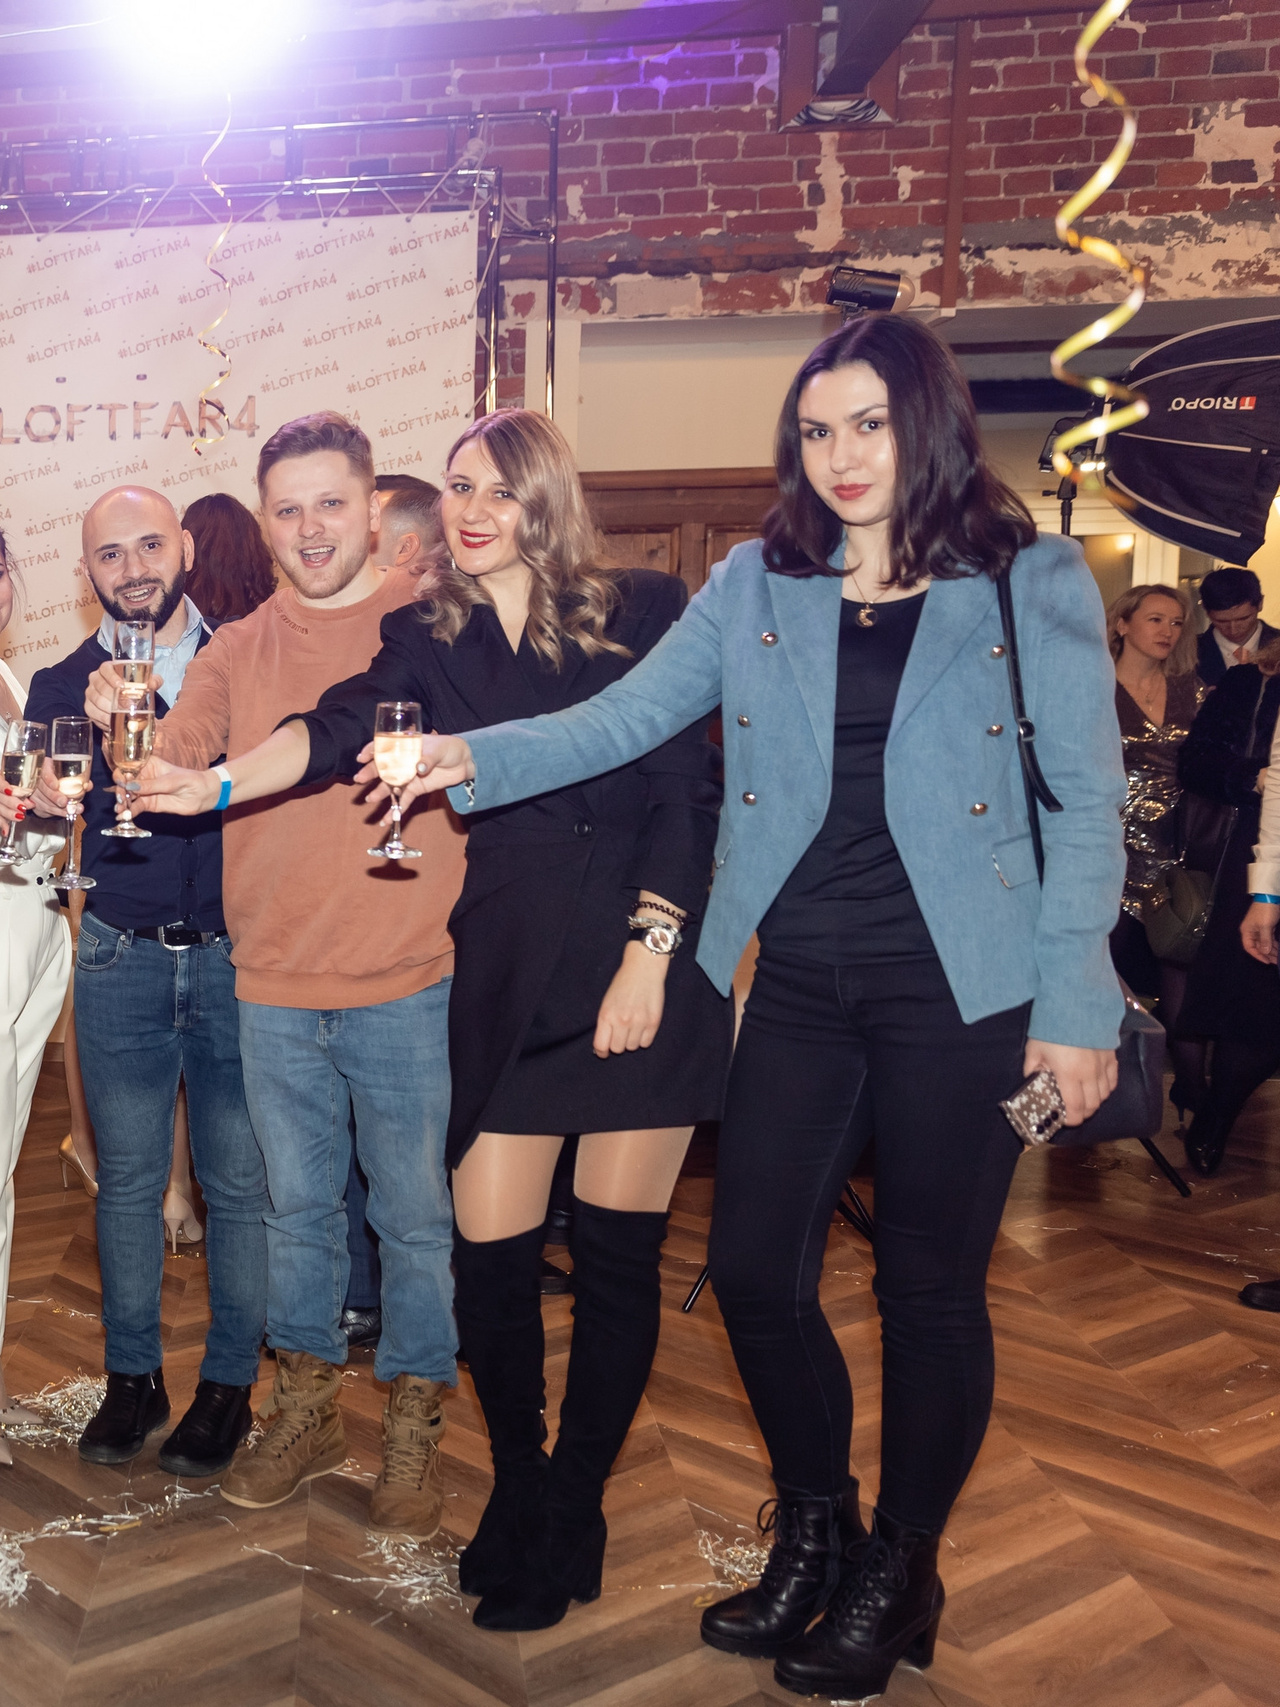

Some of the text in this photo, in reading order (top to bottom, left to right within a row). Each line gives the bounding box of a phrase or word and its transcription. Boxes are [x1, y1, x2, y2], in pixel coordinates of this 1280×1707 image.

[114, 236, 190, 270] #LOFTFAR4
[295, 226, 375, 261] #LOFTFAR4
[388, 222, 470, 257] #LOFTFAR4
[26, 241, 101, 274] #LOFTFAR4
[83, 284, 160, 317] #LOFTFAR4
[258, 273, 338, 307] #LOFTFAR4
[346, 268, 427, 302] #LOFTFAR4
[117, 326, 194, 359] #LOFTFAR4
[302, 314, 383, 348] #LOFTFAR4
[386, 314, 467, 348] #LOFTFAR4
[26, 332, 101, 364] #LOFTFAR4
[260, 360, 339, 394] #LOFTFAR4
[346, 360, 427, 394] #LOFTFAR4
[1171, 396, 1256, 411] TRIOPO
[378, 405, 459, 438] #LOFTFAR4
[73, 459, 149, 490] #LOFTFAR4
[160, 457, 238, 488] #LOFTFAR4
[24, 595, 97, 623] #LOFTFAR4
